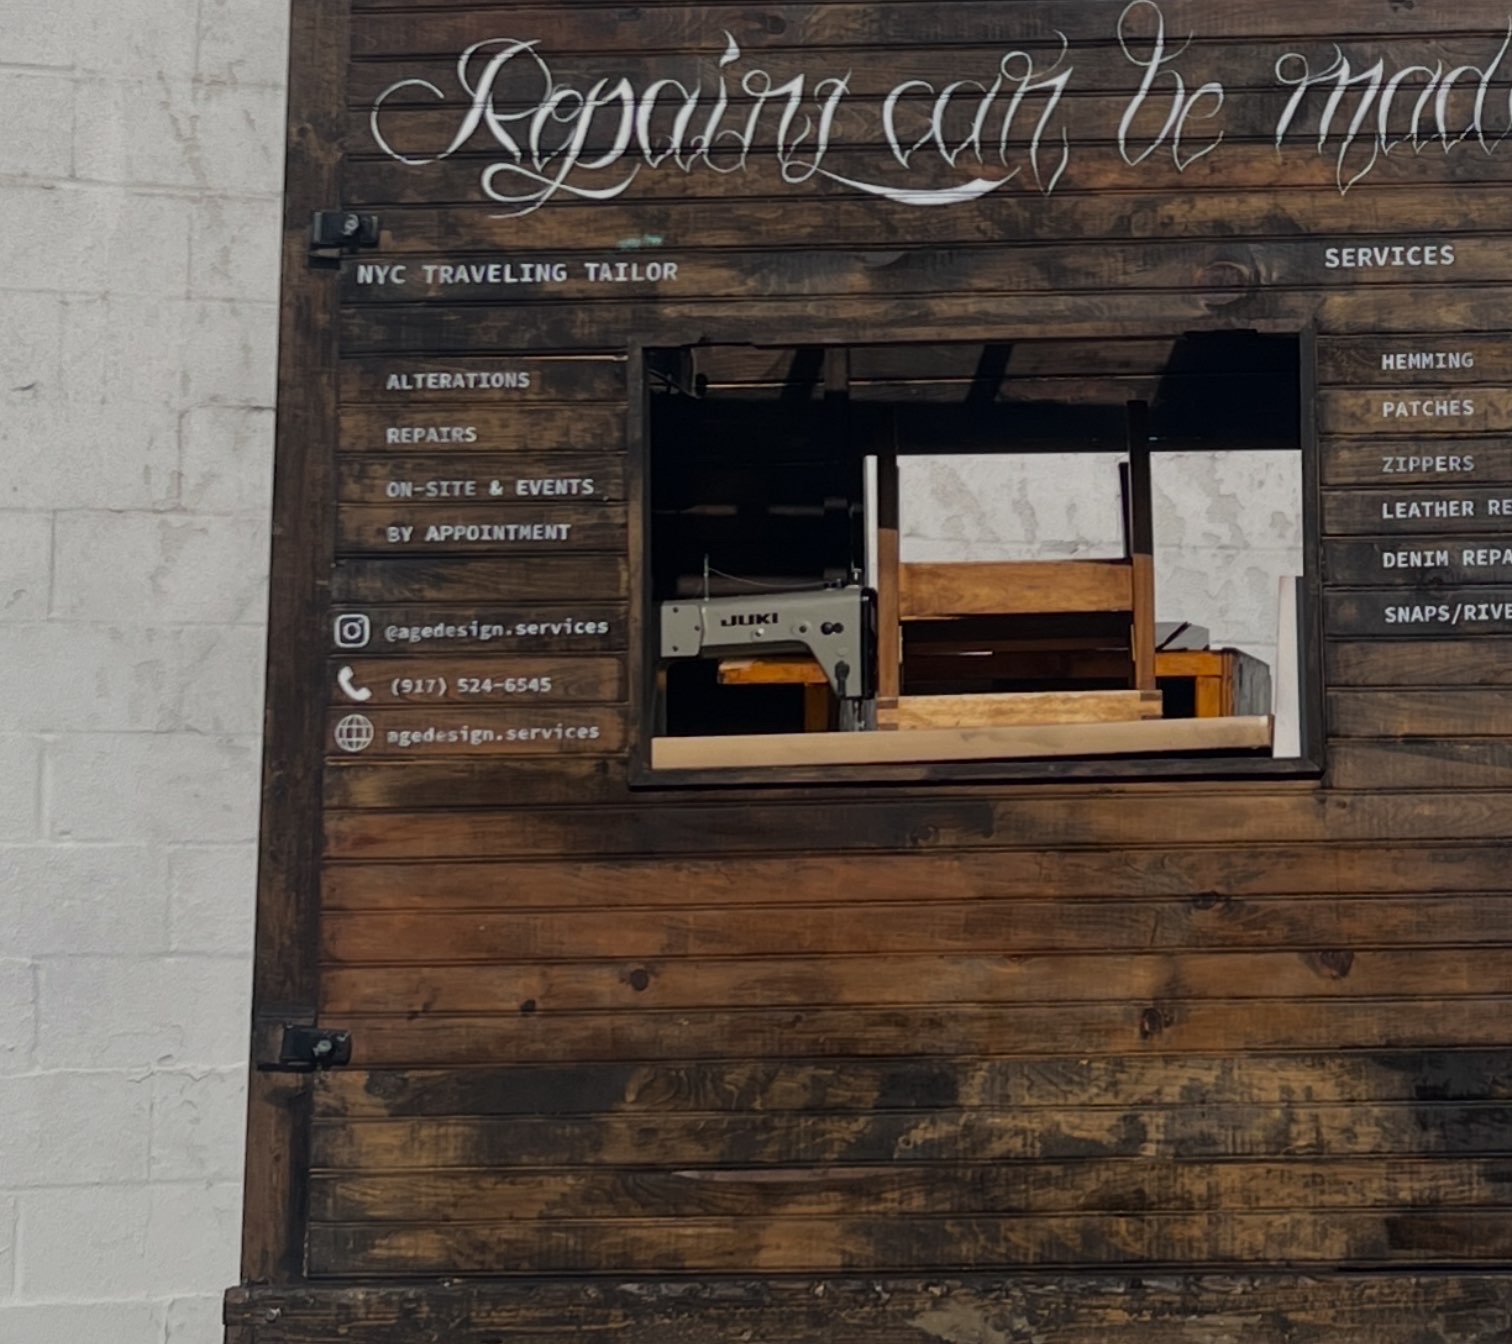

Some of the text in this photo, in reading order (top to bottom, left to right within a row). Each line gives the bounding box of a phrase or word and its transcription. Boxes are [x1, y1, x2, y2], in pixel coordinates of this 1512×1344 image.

[883, 27, 1076, 196] can
[1117, 0, 1224, 172] be
[1324, 245, 1455, 268] SERVICES
[357, 262, 679, 285] NYC TRAVELING TAILOR
[1381, 352, 1474, 370] HEMMING
[386, 372, 531, 390] ALTERATIONS
[1382, 399, 1475, 418] PATCHES
[386, 426, 478, 444] REPAIRS
[1382, 455, 1475, 473] ZIPPERS
[386, 478, 595, 498] ON-SITE & EVENTS
[1382, 500, 1474, 519] LEATHER
[387, 523, 572, 543] BY APPOINTMENT
[1382, 551, 1449, 568] DENIM
[720, 612, 779, 627] JUKI
[384, 617, 610, 643] @agedesign.services
[391, 676, 552, 697] (917) 524-6545
[386, 723, 600, 747] agedesign.services
